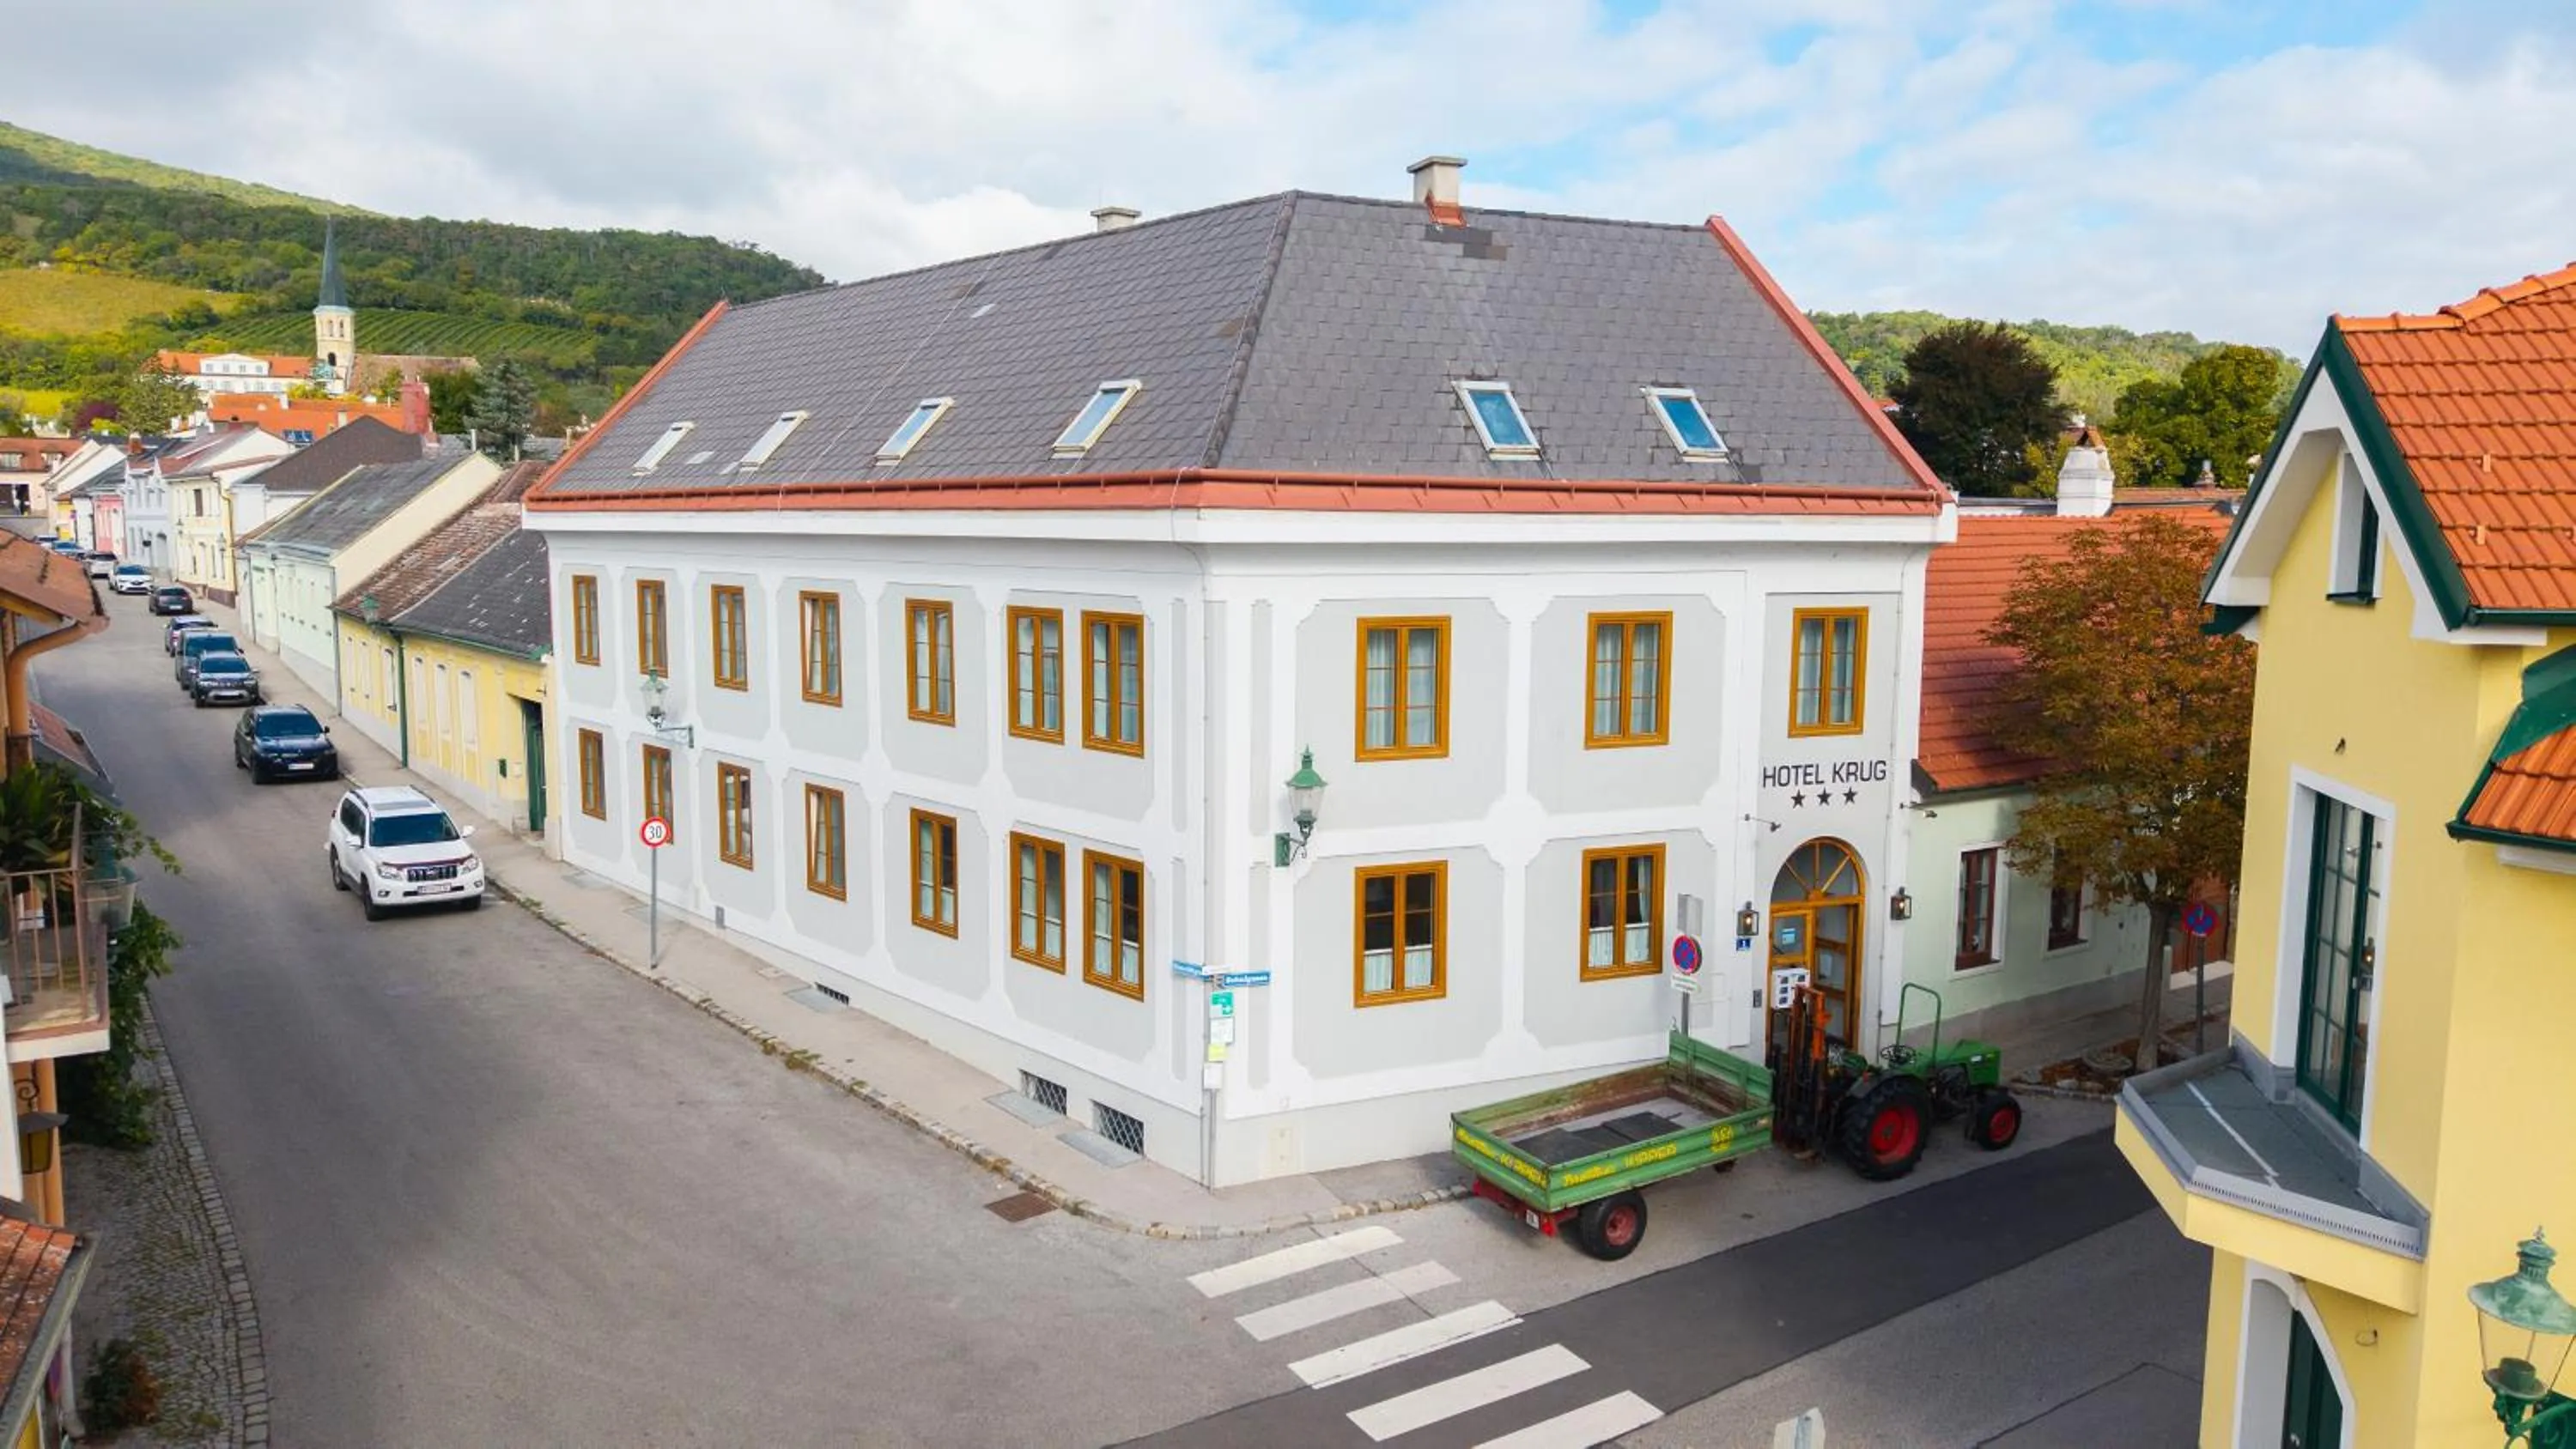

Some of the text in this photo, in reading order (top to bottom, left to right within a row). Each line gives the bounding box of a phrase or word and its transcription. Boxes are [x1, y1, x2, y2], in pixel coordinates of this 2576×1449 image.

[1763, 761, 1886, 787] HOTEL KRUG
[649, 825, 662, 840] 30
